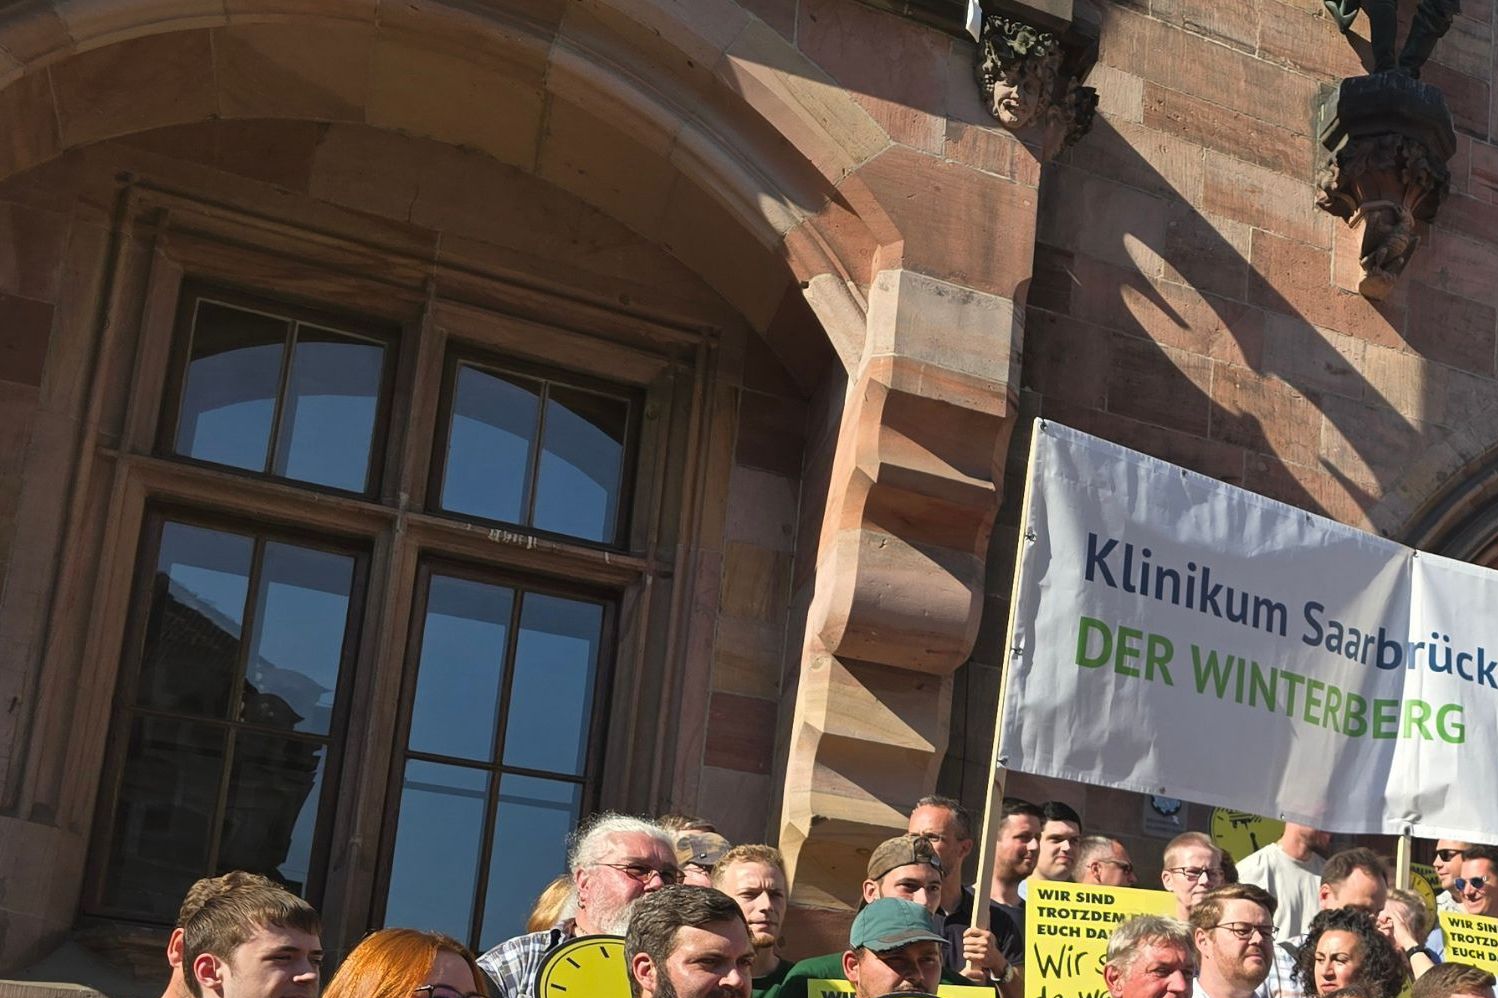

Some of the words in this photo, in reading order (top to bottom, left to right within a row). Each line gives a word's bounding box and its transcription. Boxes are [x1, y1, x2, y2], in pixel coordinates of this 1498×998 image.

[1085, 532, 1287, 637] Klinikum
[1075, 616, 1174, 686] DER
[1190, 643, 1466, 744] WINTERBERG
[1038, 888, 1071, 902] WIR
[1075, 892, 1115, 905] SIND
[1037, 906, 1125, 924] TROTZDEM
[1448, 916, 1474, 930] WIR
[1037, 924, 1081, 938] EUCH
[1034, 942, 1088, 979] Wir
[1452, 946, 1486, 961] EUCH
